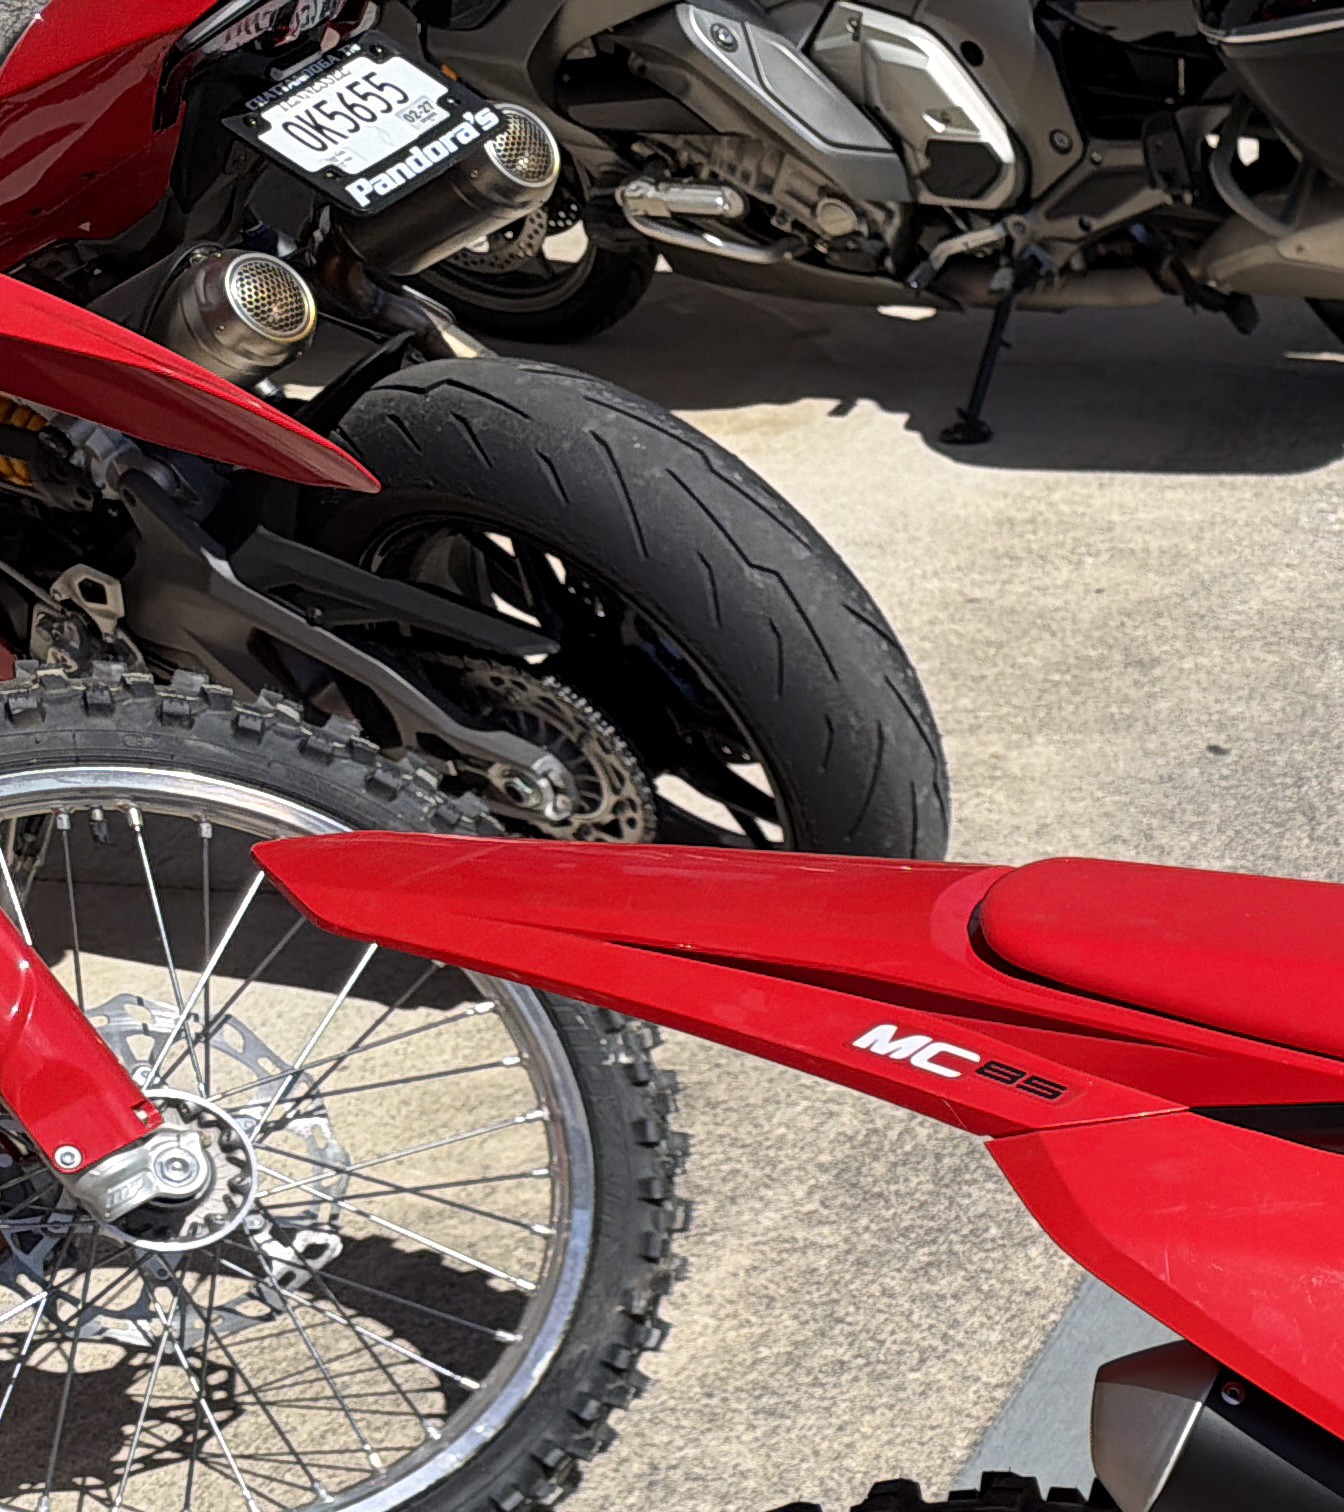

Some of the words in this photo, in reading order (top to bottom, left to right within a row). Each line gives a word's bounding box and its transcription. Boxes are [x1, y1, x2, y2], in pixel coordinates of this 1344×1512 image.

[281, 70, 410, 153] OK5655
[402, 101, 435, 124] 02-27
[344, 105, 500, 208] Pandora's
[853, 1024, 981, 1078] MC
